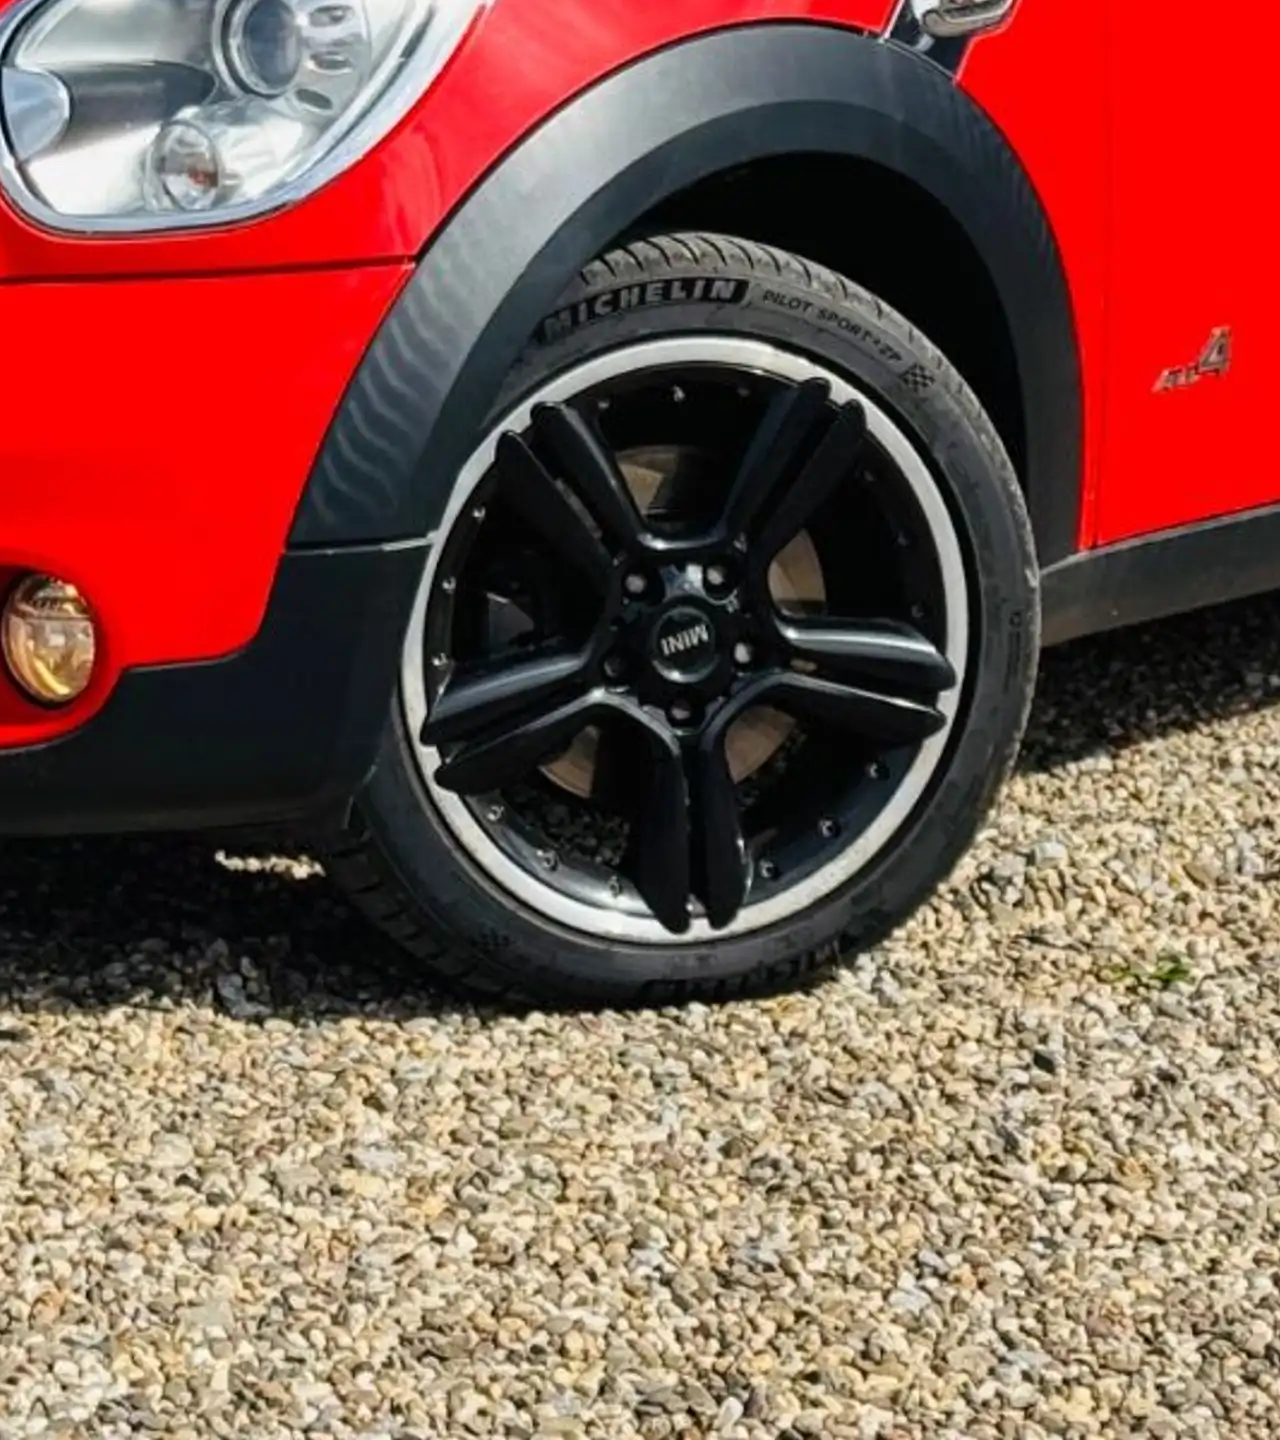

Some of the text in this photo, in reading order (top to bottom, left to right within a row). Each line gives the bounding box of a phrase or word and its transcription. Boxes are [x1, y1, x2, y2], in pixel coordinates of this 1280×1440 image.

[543, 278, 738, 346] MICHELIN
[763, 289, 814, 312] PILOT
[660, 623, 709, 656] MINI
